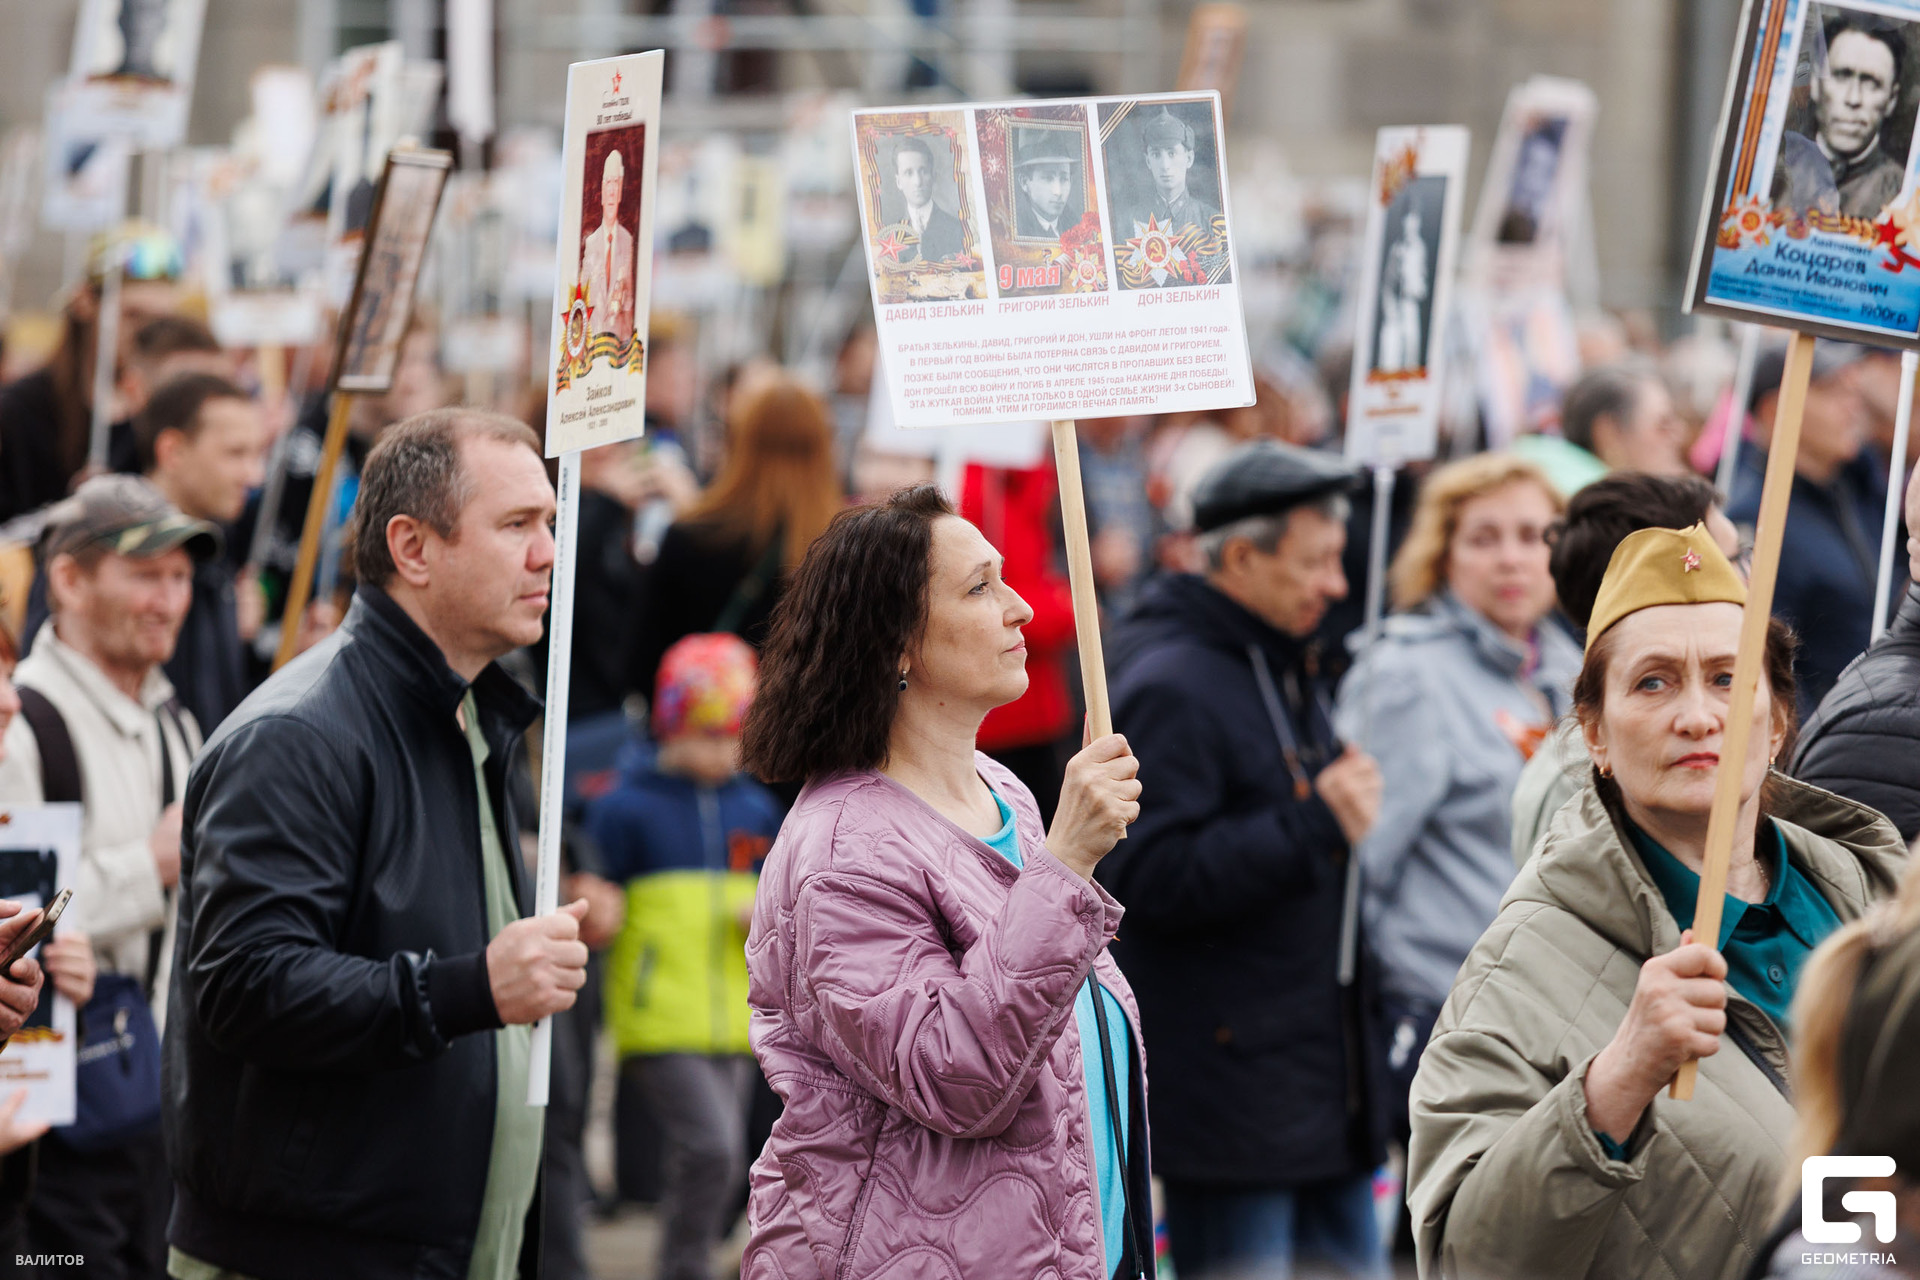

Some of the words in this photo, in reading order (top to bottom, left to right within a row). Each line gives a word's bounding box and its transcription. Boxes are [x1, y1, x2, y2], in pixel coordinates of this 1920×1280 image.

[1775, 242, 1867, 275] Коцарев
[999, 264, 1013, 289] 9
[1016, 265, 1061, 287] мая
[1744, 257, 1800, 282] Данил
[1805, 267, 1889, 297] Иванович
[998, 298, 1056, 314] ГРИГОРИЙ
[1059, 295, 1109, 309] ЗЕЛЬКИН
[1137, 292, 1163, 307] ДОН
[1165, 289, 1220, 303] ЗЕЛЬКИН
[885, 306, 927, 322] ДАВИД
[929, 304, 984, 319] ЗЕЛЬКИН
[898, 342, 930, 352] БРАТЬЯ
[932, 340, 980, 351] ЗЕЛЬКИНЫ,
[981, 338, 1013, 348] ДАВИД,
[1014, 333, 1057, 345] ГРИГОРИЙ
[1060, 335, 1066, 343] И
[1067, 333, 1088, 343] ДОН,
[1089, 331, 1113, 341] УШЛИ
[1115, 330, 1127, 339] НА
[1129, 329, 1157, 338] ФРОНТ
[1159, 327, 1187, 337] ЛЕТОМ
[1190, 325, 1207, 334] 1941
[1209, 325, 1230, 334] года.
[909, 358, 916, 366] В
[918, 354, 953, 366] ПЕРВЫЙ
[955, 355, 972, 364] ГОД
[973, 352, 1005, 363] ВОЙНЫ
[1007, 351, 1032, 361] БЫЛА
[1034, 348, 1078, 359] ПОТЕРЯНА
[1080, 347, 1108, 357] СВЯЗЬ
[1110, 345, 1116, 354] С
[1117, 343, 1160, 355] ДАВИДОМ
[1162, 343, 1168, 351] И
[1170, 339, 1222, 350] ГРИГОРИЕМ.
[904, 372, 933, 383] ПОЗЖЕ
[936, 371, 962, 381] БЫЛИ
[964, 367, 1022, 380] СООБЩЕНИЯ,
[1024, 366, 1041, 375] ЧТО
[1043, 365, 1061, 374] ОНИ
[1064, 361, 1110, 373] ЧИСЛЯТСЯ
[1111, 361, 1118, 369] В
[1120, 357, 1175, 369] ПРОПАВШИХ
[1176, 355, 1193, 365] БЕЗ
[1195, 353, 1227, 364] ВЕСТИ!
[586, 384, 612, 401] Зайков
[904, 387, 921, 397] ДОН
[923, 384, 957, 396] ПРОШЁЛ
[959, 384, 978, 394] ВСЮ
[980, 381, 1008, 392] ВОЙНУ
[1009, 382, 1015, 390] И
[1017, 380, 1044, 390] ПОГИБ
[1046, 379, 1052, 388] В
[1054, 377, 1085, 388] АПРЕЛЕ
[1088, 375, 1105, 385] 1945
[1106, 376, 1124, 385] года
[1126, 371, 1168, 383] НАКАНУНЕ
[1170, 370, 1188, 380] ДНЯ
[1189, 368, 1228, 379] ПОБЕДЫ!
[909, 400, 925, 409] ЭТА
[927, 397, 962, 408] ЖУТКАЯ
[964, 394, 994, 405] ВОЙНА
[995, 393, 1029, 404] УНЕСЛА
[1031, 390, 1066, 401] ТОЛЬКО
[1068, 391, 1074, 399] В
[1076, 387, 1107, 399] ОДНОЙ
[1109, 385, 1138, 396] СЕМЬЕ
[1140, 384, 1172, 394] ЖИЗНИ
[1174, 383, 1185, 392] 3-х
[1187, 379, 1235, 391] СЫНОВЕЙ!
[560, 408, 587, 424] Алексей
[588, 398, 636, 417] Александрович
[996, 404, 1019, 413] ЧТИМ
[1021, 404, 1028, 412] И
[1029, 400, 1081, 412] ГОРДИМСЯ!
[1083, 398, 1117, 408] ВЕЧНАЯ
[1119, 396, 1158, 406] ПАМЯТЬ!
